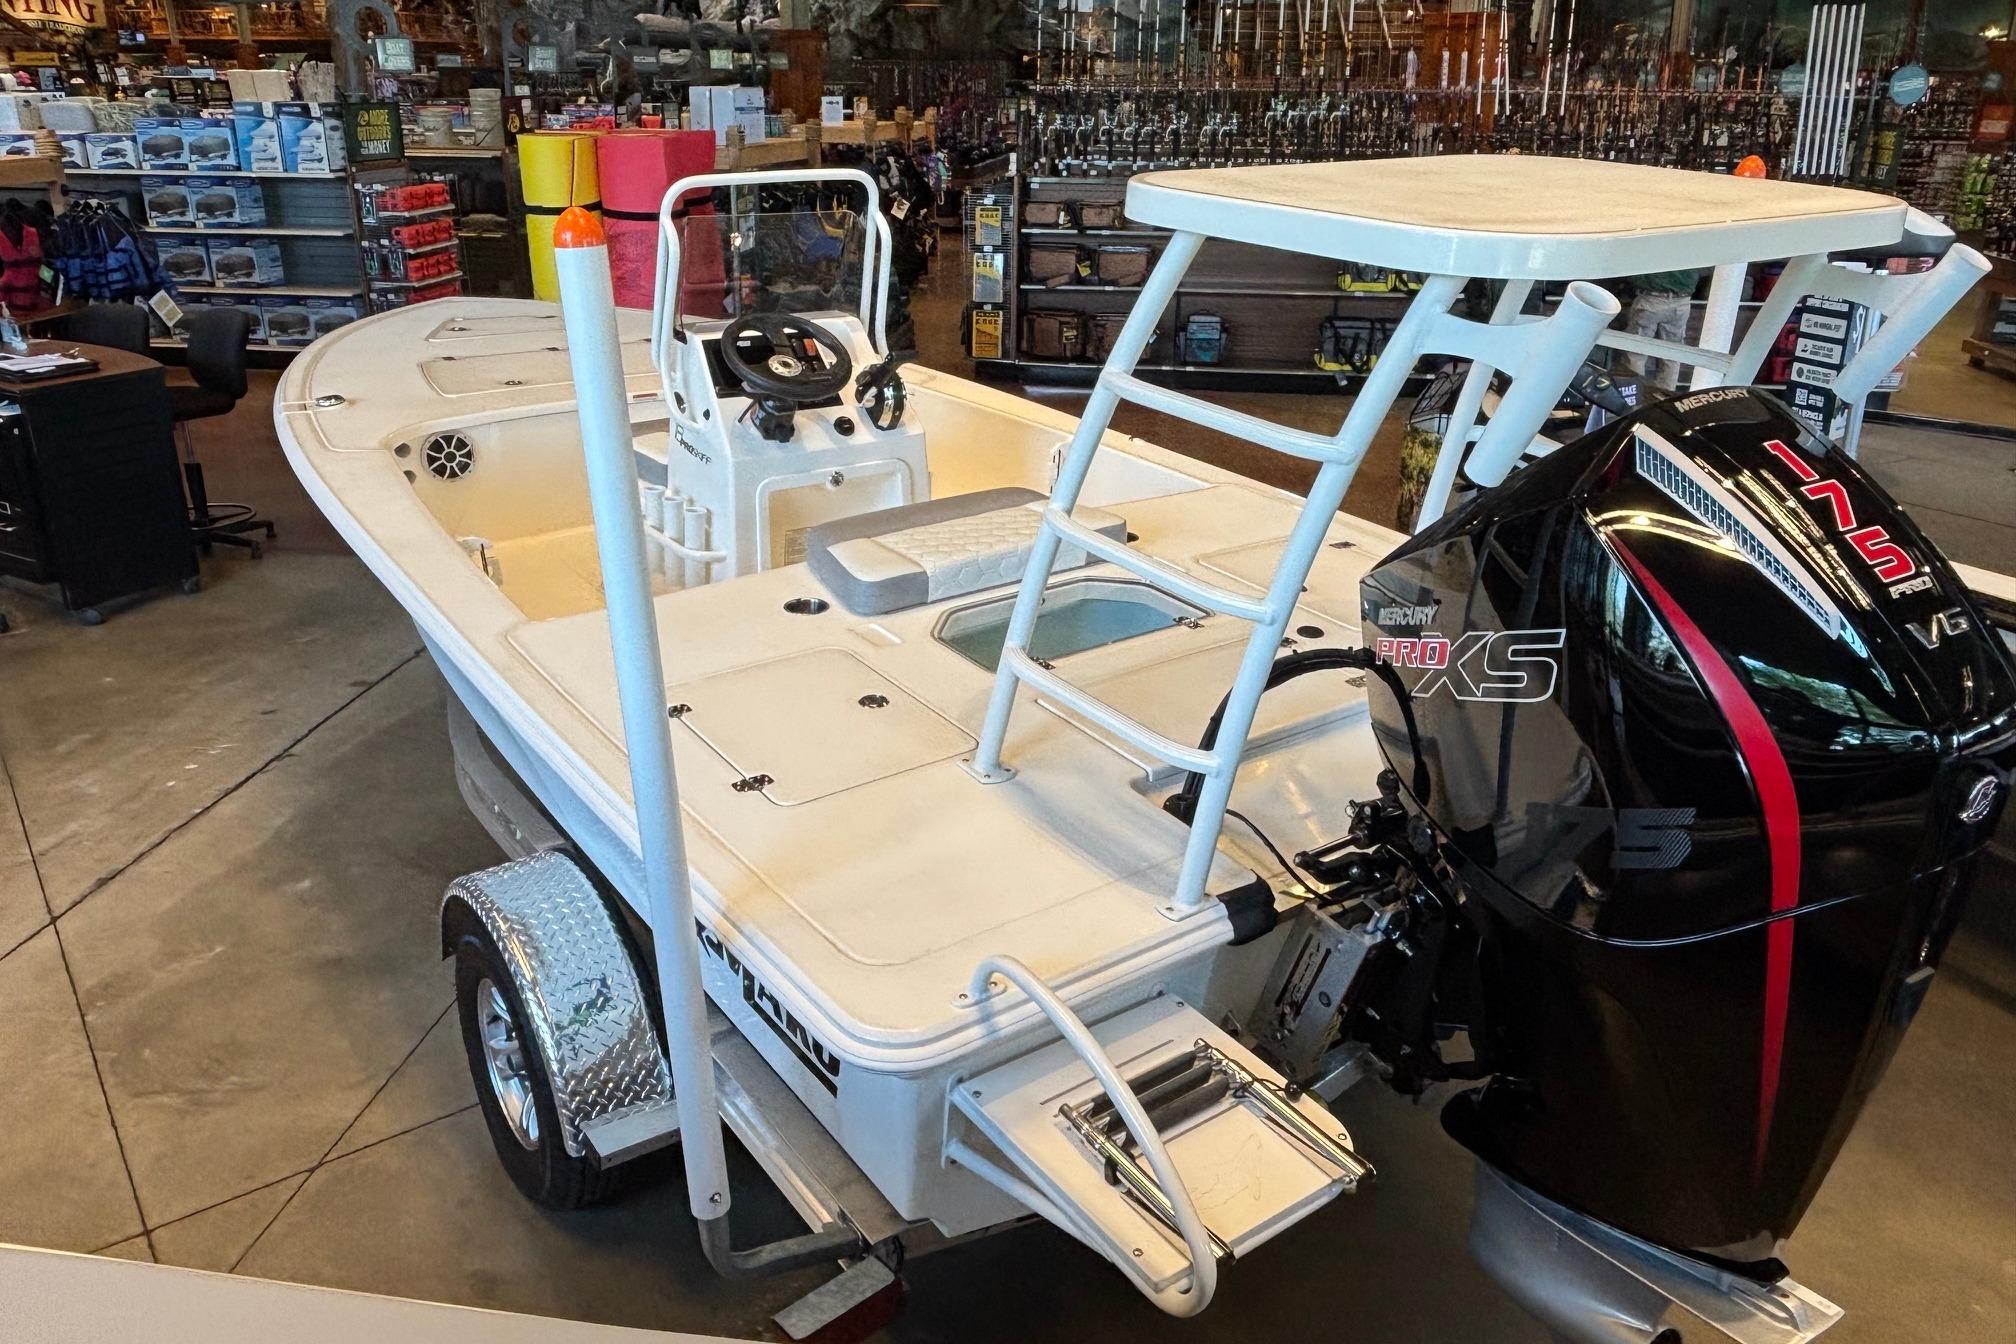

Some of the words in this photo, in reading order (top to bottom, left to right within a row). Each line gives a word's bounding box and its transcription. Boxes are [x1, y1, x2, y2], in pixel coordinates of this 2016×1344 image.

[1674, 388, 1750, 413] MERCURY
[1763, 439, 1916, 583] 175
[1378, 605, 1440, 626] MERCURY
[1904, 607, 1971, 650] V6
[1376, 637, 1451, 670] PRO
[1411, 628, 1567, 703] XS
